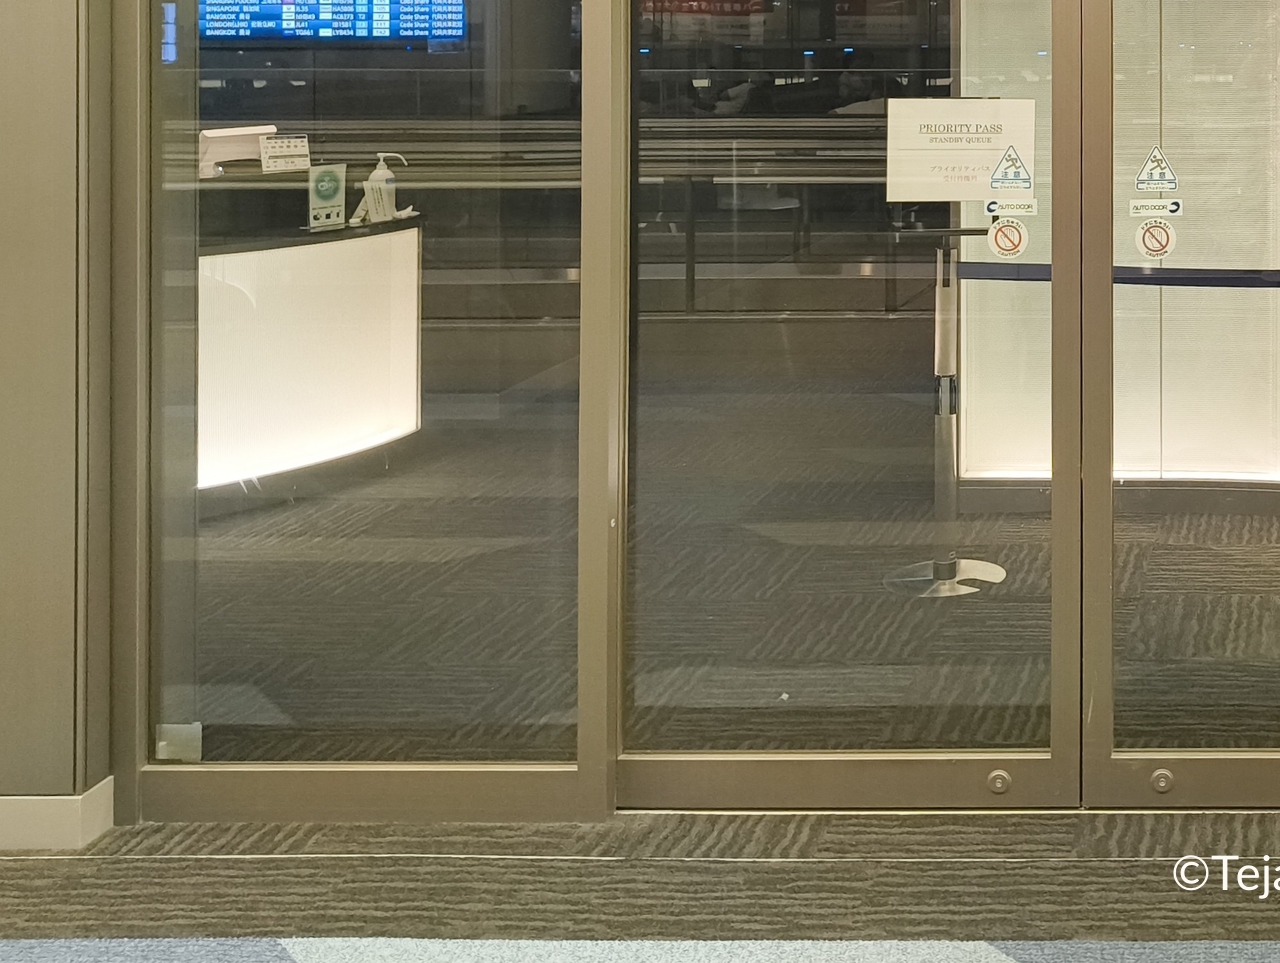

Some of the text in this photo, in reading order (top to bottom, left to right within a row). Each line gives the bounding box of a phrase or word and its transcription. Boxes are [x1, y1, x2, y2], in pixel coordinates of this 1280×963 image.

[919, 124, 1003, 133] PRIORITY PASS
[997, 249, 1021, 257] CAUTION
[1145, 249, 1169, 257] CAUTION
